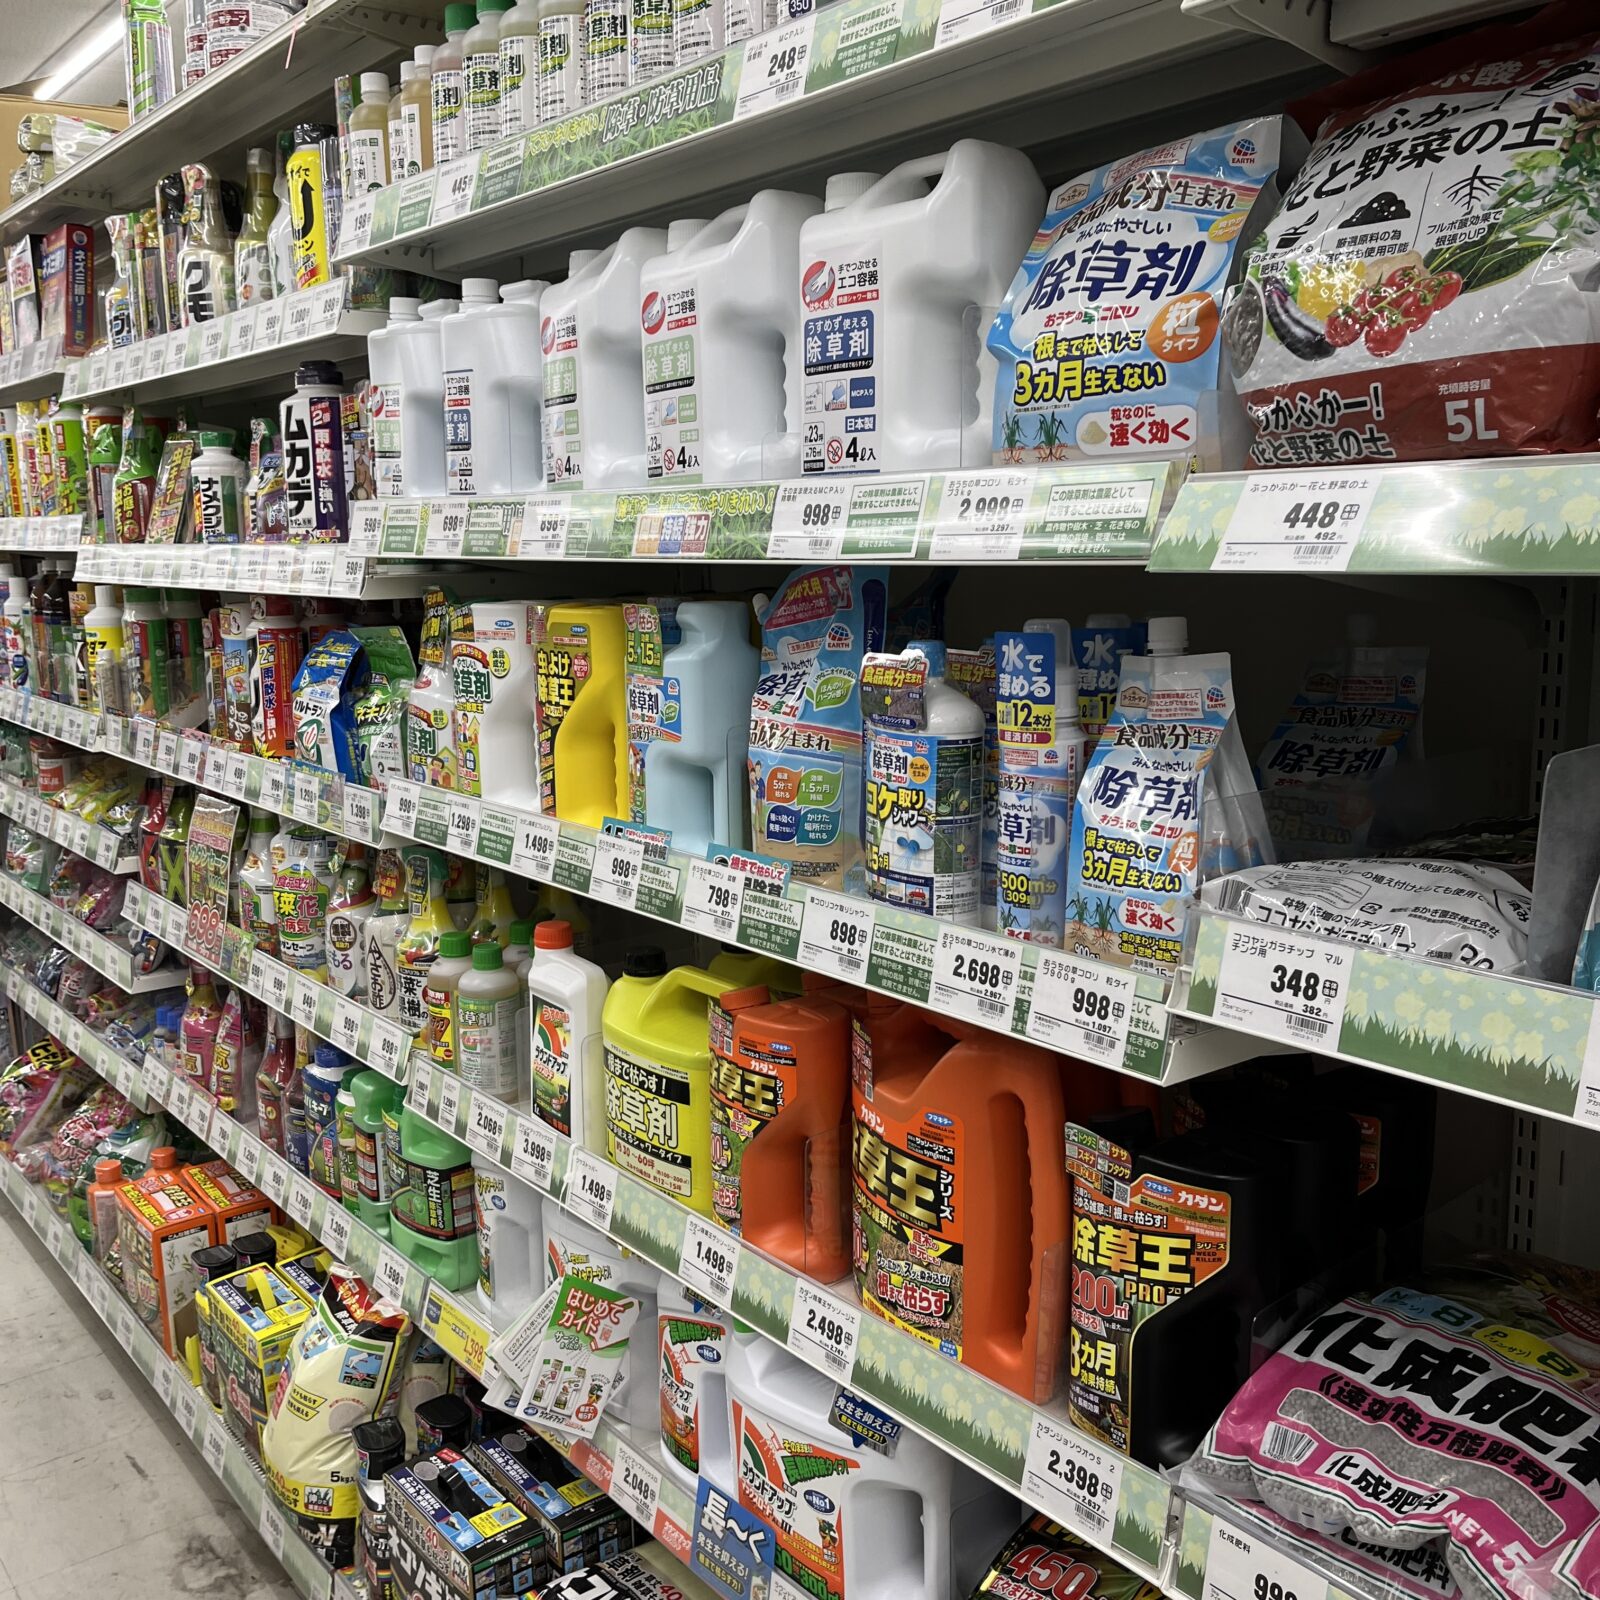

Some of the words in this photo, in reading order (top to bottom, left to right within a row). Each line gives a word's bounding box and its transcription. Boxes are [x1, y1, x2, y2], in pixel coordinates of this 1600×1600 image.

[767, 47, 796, 78] 248
[451, 174, 469, 197] 445
[1076, 217, 1171, 243] みんなにやさしい
[1427, 210, 1502, 236] フルボ酸効果で
[1336, 229, 1401, 249] 厳選原料の為
[1435, 226, 1486, 248] 根張りUP
[838, 258, 878, 275] 手でつぶせる
[1021, 239, 1206, 315] 除草剤
[837, 270, 879, 290] エコ容器
[667, 288, 695, 301] 手でつぶせる
[667, 299, 696, 316] エコ容器
[808, 316, 868, 334] うすめず使える
[1162, 300, 1200, 336] 粒
[806, 328, 870, 364] 除草剤
[1034, 329, 1146, 363] 根まで枯らして
[1162, 337, 1199, 352] タイプ
[646, 350, 691, 383] 除草剤
[851, 388, 874, 397] MCP入り
[1438, 380, 1491, 395] 充填時容量
[847, 417, 874, 431] 日本製
[1111, 406, 1155, 420] 粒なのに
[1445, 398, 1499, 442] 5L
[1110, 418, 1191, 447] 速く効く
[285, 404, 313, 518] ムカデ
[1051, 487, 1136, 502] この除草剤は農薬として
[803, 504, 830, 526] 998
[1284, 501, 1340, 529] 448
[1315, 532, 1337, 541] 492
[537, 649, 572, 674] 虫よけ
[1002, 638, 1044, 673] 水で
[537, 676, 576, 706] 除草王
[821, 679, 847, 692] ほんのり
[863, 667, 922, 689] 食品成分生まれ
[998, 675, 1052, 698] 薄める
[629, 687, 660, 717] 除草剤
[1004, 733, 1038, 744] 経済的!
[872, 751, 908, 775] 除草剤
[1267, 740, 1388, 777] 除草剤
[399, 797, 412, 813] 998
[1092, 766, 1200, 822] 除草剤
[804, 822, 832, 832] 場所だけ
[807, 814, 830, 823] かけた
[892, 804, 928, 826] シャワー
[808, 831, 828, 840] 枯れる
[1084, 827, 1163, 862] 根まで枯らして
[611, 857, 630, 878] 998
[730, 855, 785, 881] 根まで枯らして
[708, 885, 730, 908] 798
[744, 894, 794, 914] この除草剤は農薬として
[1127, 898, 1155, 911] 粒なのに
[187, 899, 222, 951] 698
[742, 904, 799, 927] 使用することはできません。
[1125, 908, 1175, 932] 速く効く
[1411, 905, 1501, 937] あかぎ園芸株式会社
[830, 919, 858, 946] 898
[942, 932, 1017, 959] おうちの草コロリ水で薄め
[1231, 943, 1268, 960] チング用
[1232, 932, 1315, 959] ココヤシガラチップ
[1324, 952, 1344, 966] マル
[952, 954, 1001, 989] 2,698
[1042, 958, 1100, 982] おうちの草コロリ
[1106, 976, 1129, 990] 粒タイ
[1270, 964, 1321, 1001] 348
[1072, 988, 1111, 1021] 998
[1302, 1003, 1322, 1018] 382
[608, 1052, 668, 1096] 根まで枯らす!
[750, 1060, 778, 1076] カダン
[775, 1079, 785, 1106] シリーズ
[605, 1072, 679, 1149] 除草剤
[860, 1104, 886, 1135] カダン
[1077, 1132, 1097, 1149] ドクダミ
[1111, 1146, 1129, 1161] ササ
[1077, 1149, 1096, 1165] スギナ
[1107, 1160, 1131, 1179] ブタクサ
[939, 1169, 955, 1222] シリーズ
[1178, 1190, 1225, 1213] カダン
[1113, 1204, 1169, 1229] 根まで枯らす!
[1073, 1216, 1192, 1285] 除草王
[1195, 1242, 1226, 1251] シリーズ
[1195, 1250, 1218, 1259] WEED
[876, 1270, 950, 1317] 根まで枯らす
[1124, 1280, 1167, 1306] PRO
[1167, 1286, 1182, 1295] プロ
[566, 1287, 626, 1325] はじめて
[559, 1308, 601, 1337] ガイド
[806, 1308, 844, 1347] 2,498
[1080, 1368, 1117, 1396] 効果持続
[835, 1395, 901, 1437] 発生を抑える!
[1037, 1422, 1102, 1466] カダンジョソウオウS
[1109, 1464, 1116, 1474] 2
[1048, 1449, 1100, 1498] 2,398
[743, 1460, 798, 1517] ラウンドアップ
[1218, 1528, 1252, 1555] 化成肥料
[1444, 1509, 1495, 1548] NET
[697, 1533, 749, 1580] 発生を抑える!
[1006, 1545, 1098, 1600] 450
